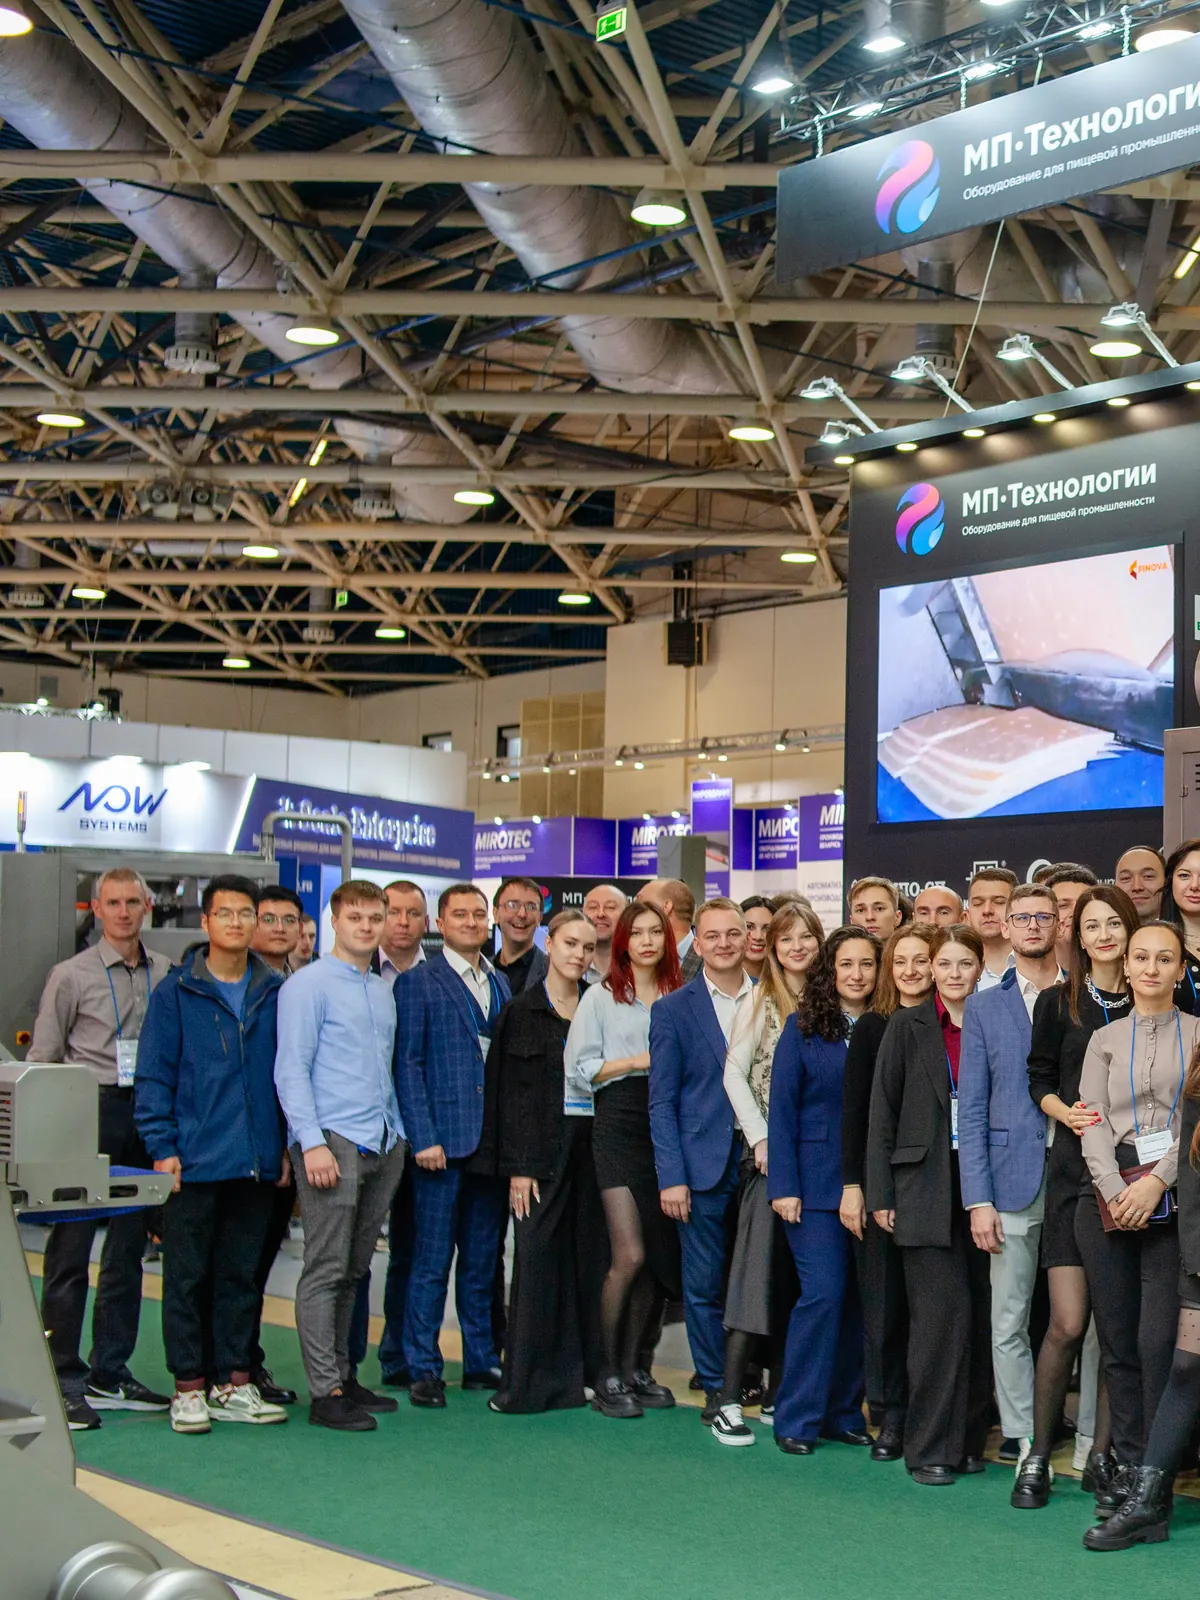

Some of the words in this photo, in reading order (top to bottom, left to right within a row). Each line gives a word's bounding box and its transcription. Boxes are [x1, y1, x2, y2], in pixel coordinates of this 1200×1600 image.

[963, 170, 1042, 200] Оборудование
[1043, 163, 1064, 178] для
[1066, 146, 1118, 171] пищевой
[962, 518, 1020, 536] Оборудование
[1021, 515, 1037, 528] для
[1038, 507, 1076, 523] пищевой
[1078, 495, 1155, 517] промышленности
[1138, 562, 1168, 573] FINOVA
[57, 782, 168, 815] NOW
[79, 818, 148, 833] SYSTEMS
[475, 829, 533, 851] MIROTEC
